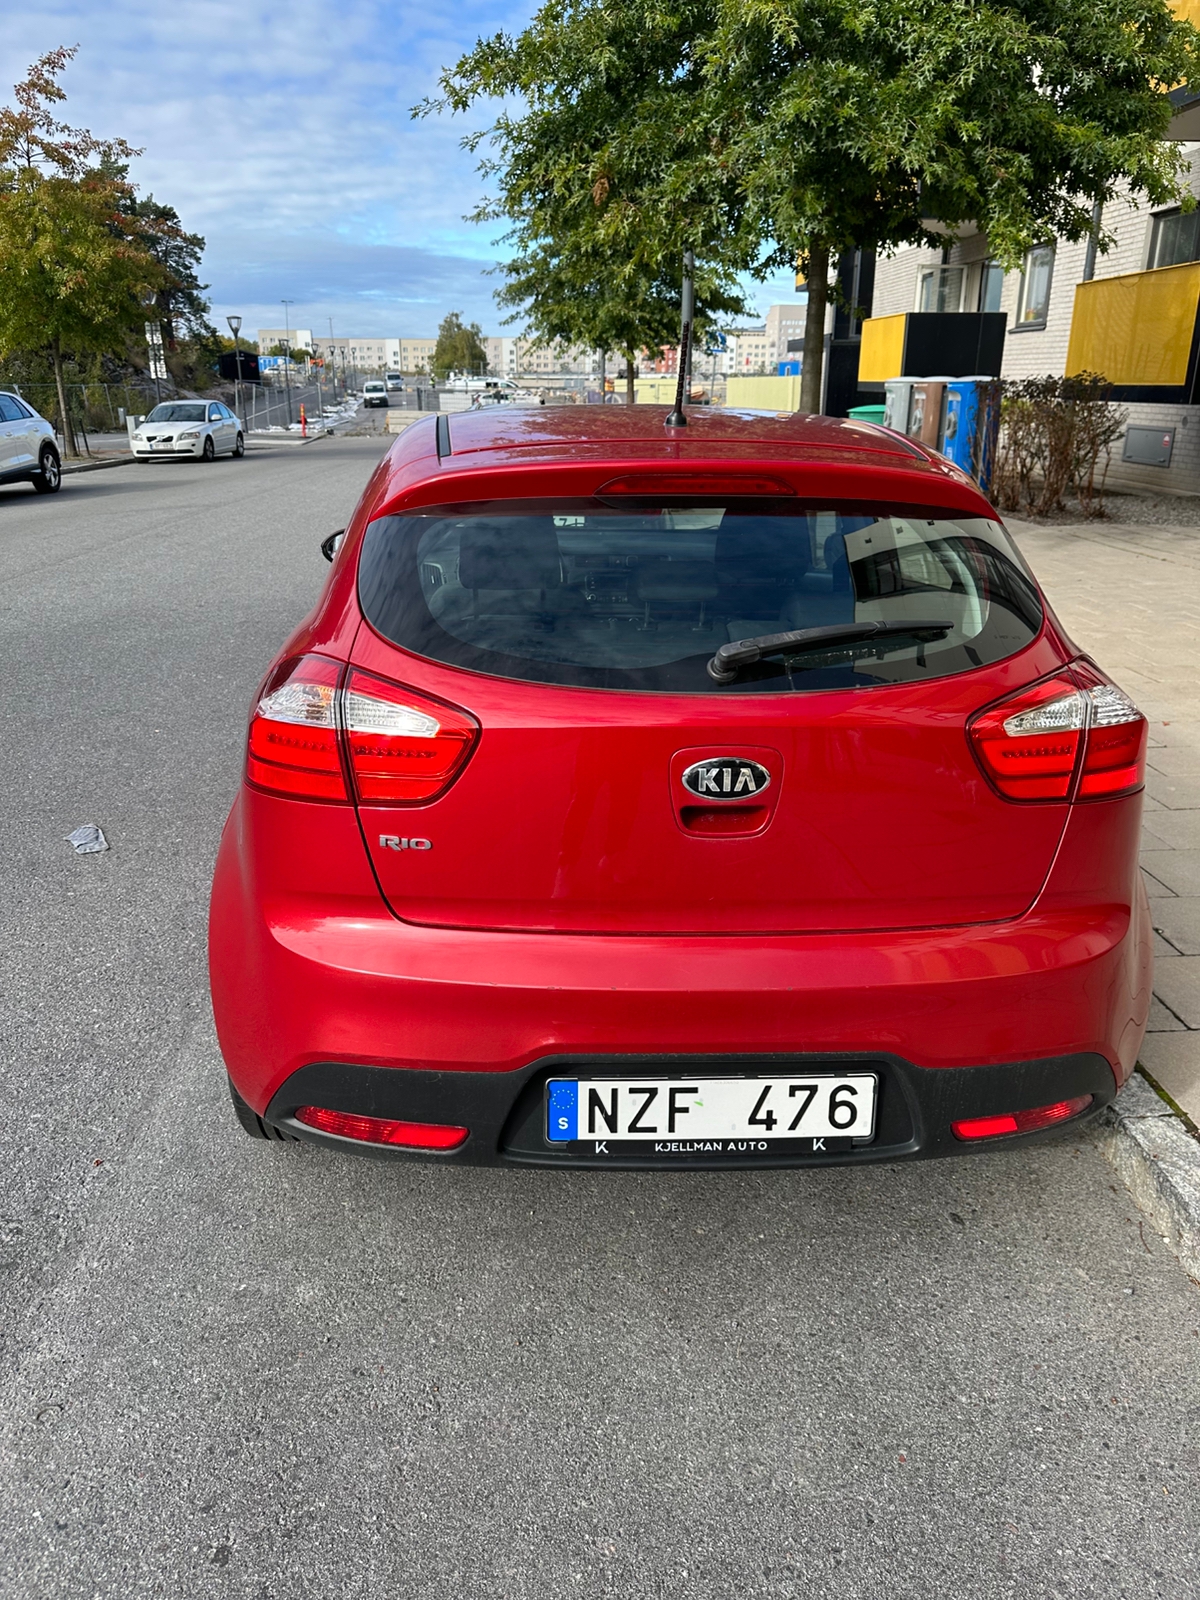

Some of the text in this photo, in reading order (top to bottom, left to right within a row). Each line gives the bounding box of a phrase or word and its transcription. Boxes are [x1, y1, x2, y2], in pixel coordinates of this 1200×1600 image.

[697, 768, 757, 792] KIA
[378, 834, 432, 851] RIO
[558, 1084, 859, 1134] S NZF 476
[595, 1138, 827, 1154] K KJELLMAN AUTO K
